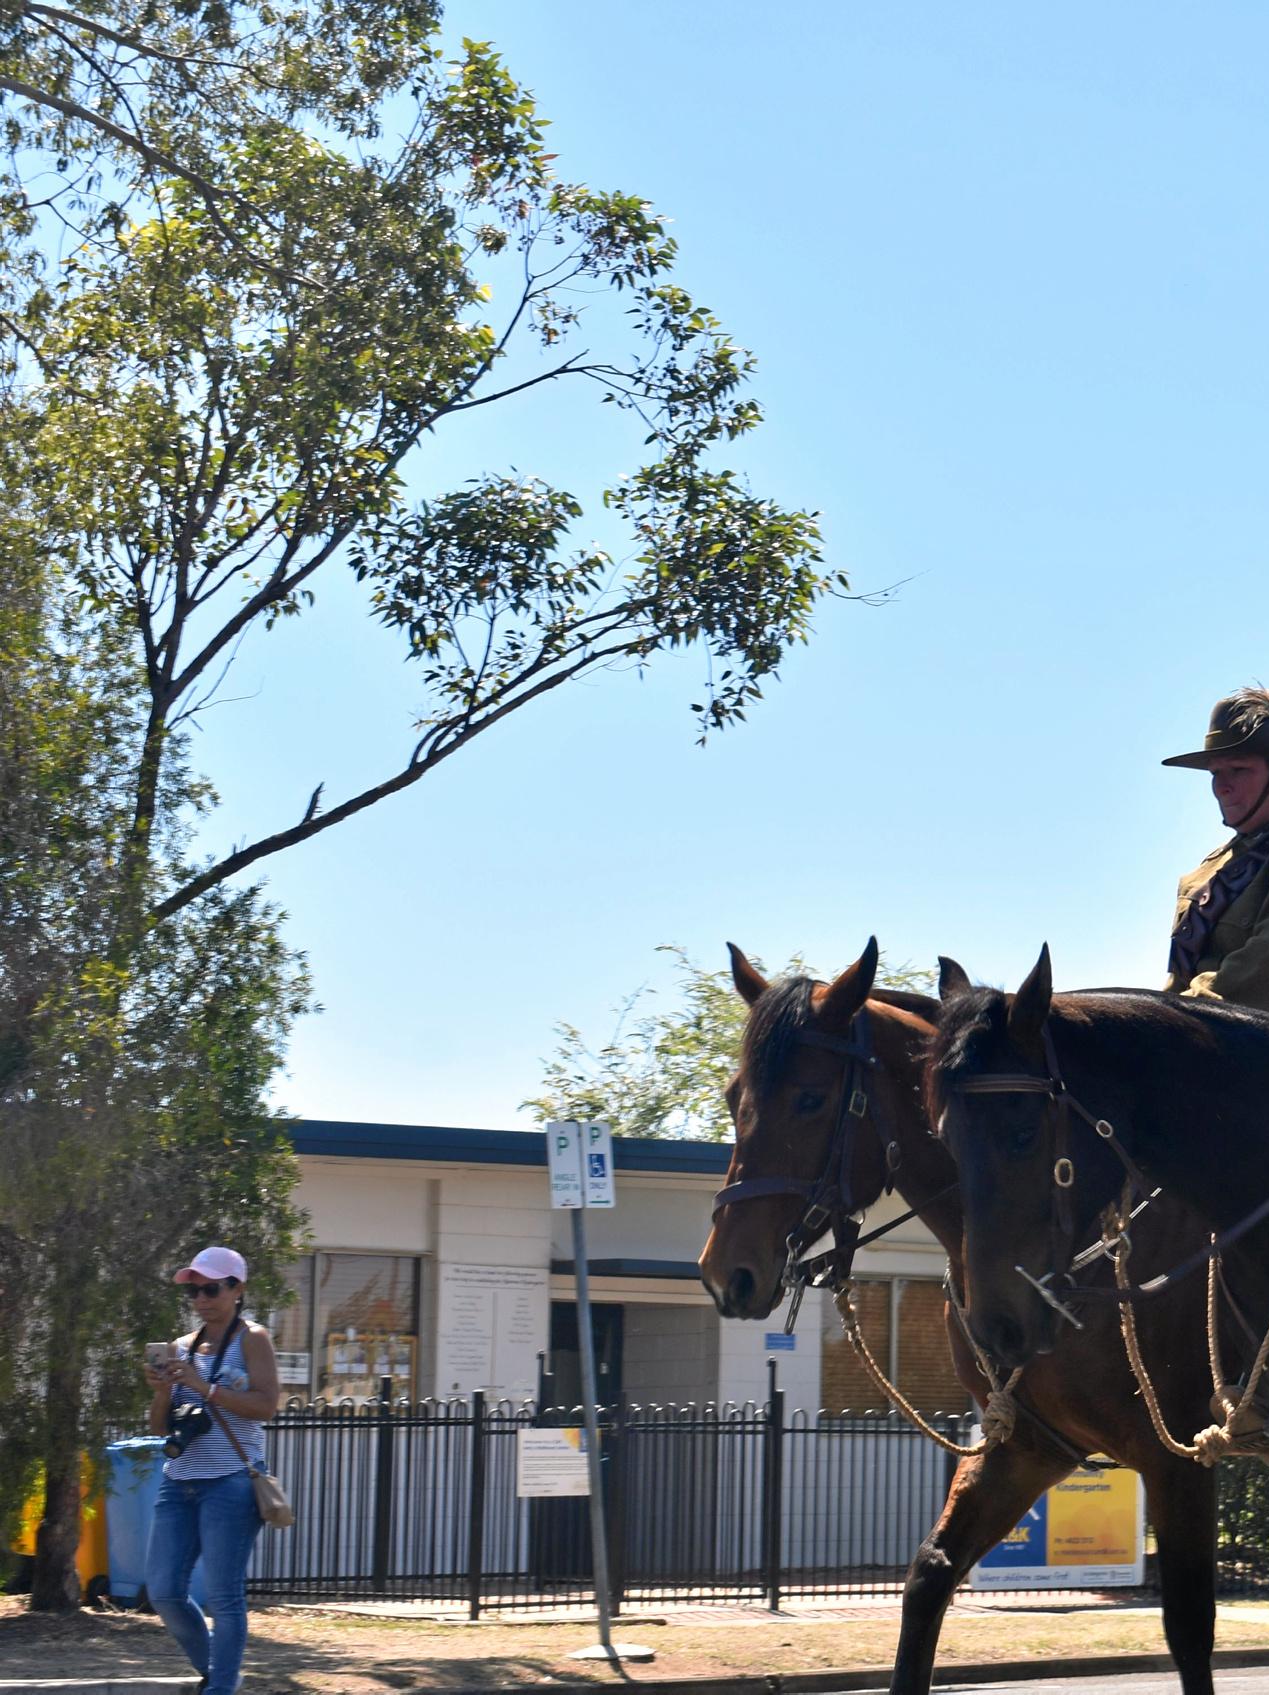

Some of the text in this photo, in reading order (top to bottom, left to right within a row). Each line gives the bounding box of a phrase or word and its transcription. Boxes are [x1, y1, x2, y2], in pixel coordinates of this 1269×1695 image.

[556, 1136, 570, 1156] P
[589, 1126, 601, 1146] P
[1056, 1484, 1111, 1493] Kindergarten
